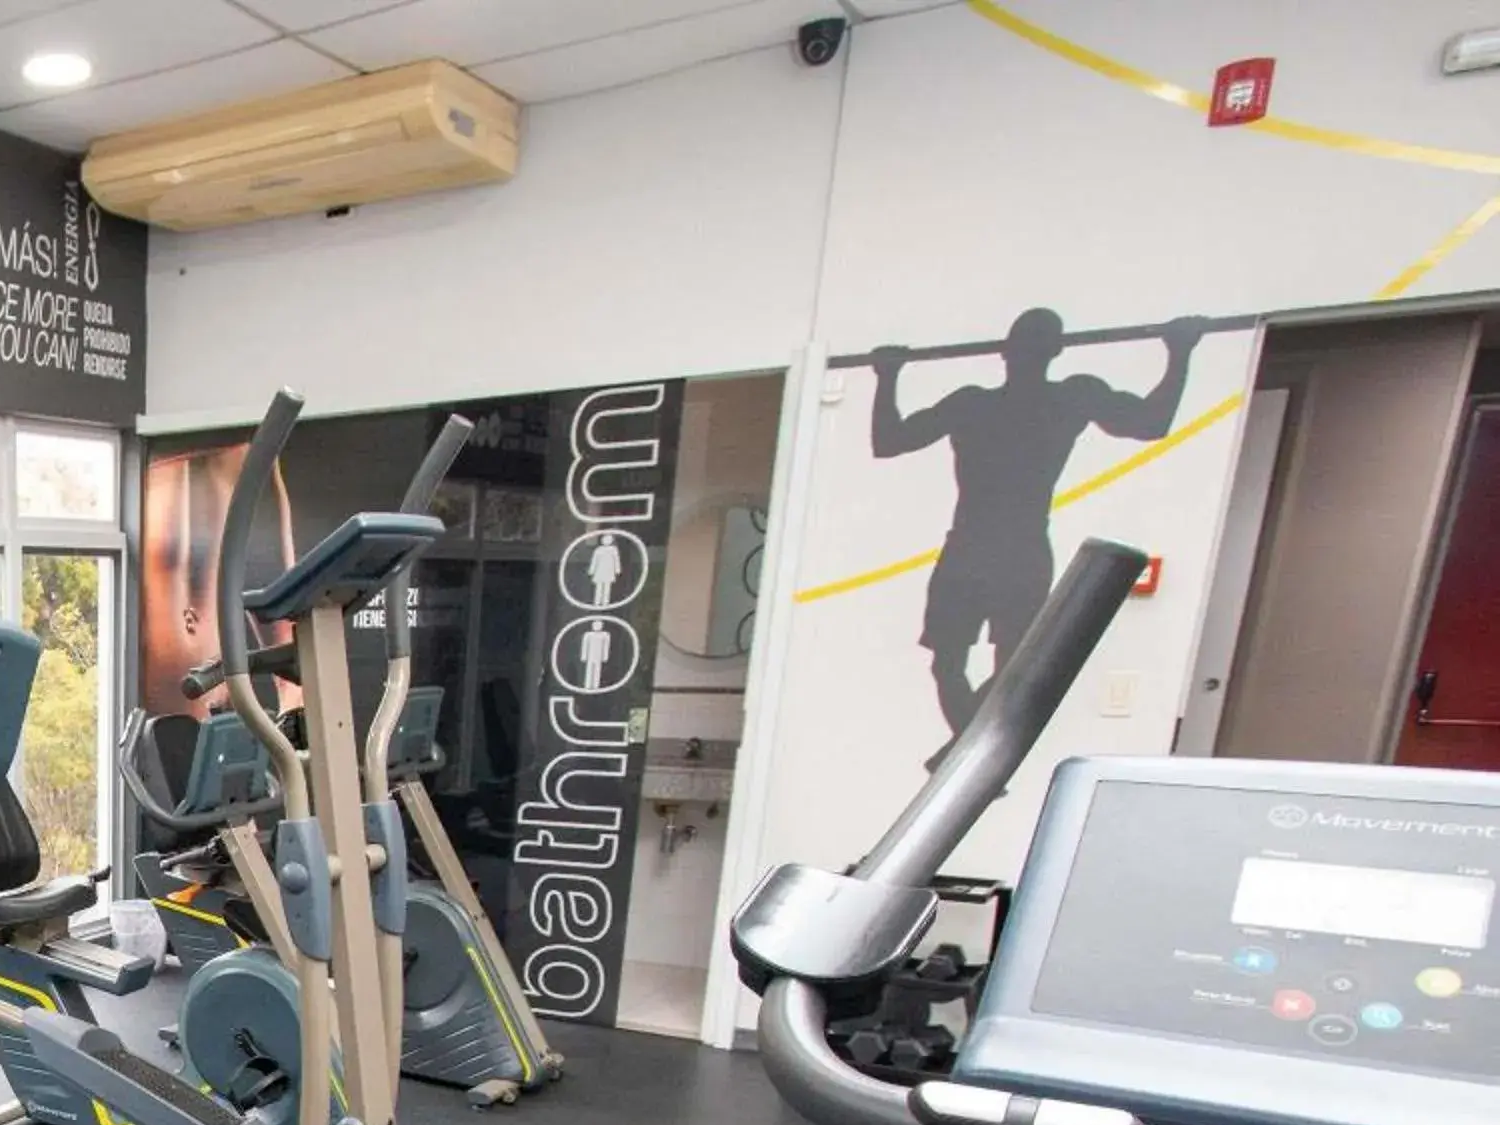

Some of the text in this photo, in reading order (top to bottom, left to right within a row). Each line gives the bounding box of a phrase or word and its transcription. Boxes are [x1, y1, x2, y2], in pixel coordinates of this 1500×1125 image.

[22, 287, 79, 332] MORE
[33, 330, 79, 372] CAN!
[514, 384, 665, 1018] bathroom
[1311, 811, 1500, 839] Movement
